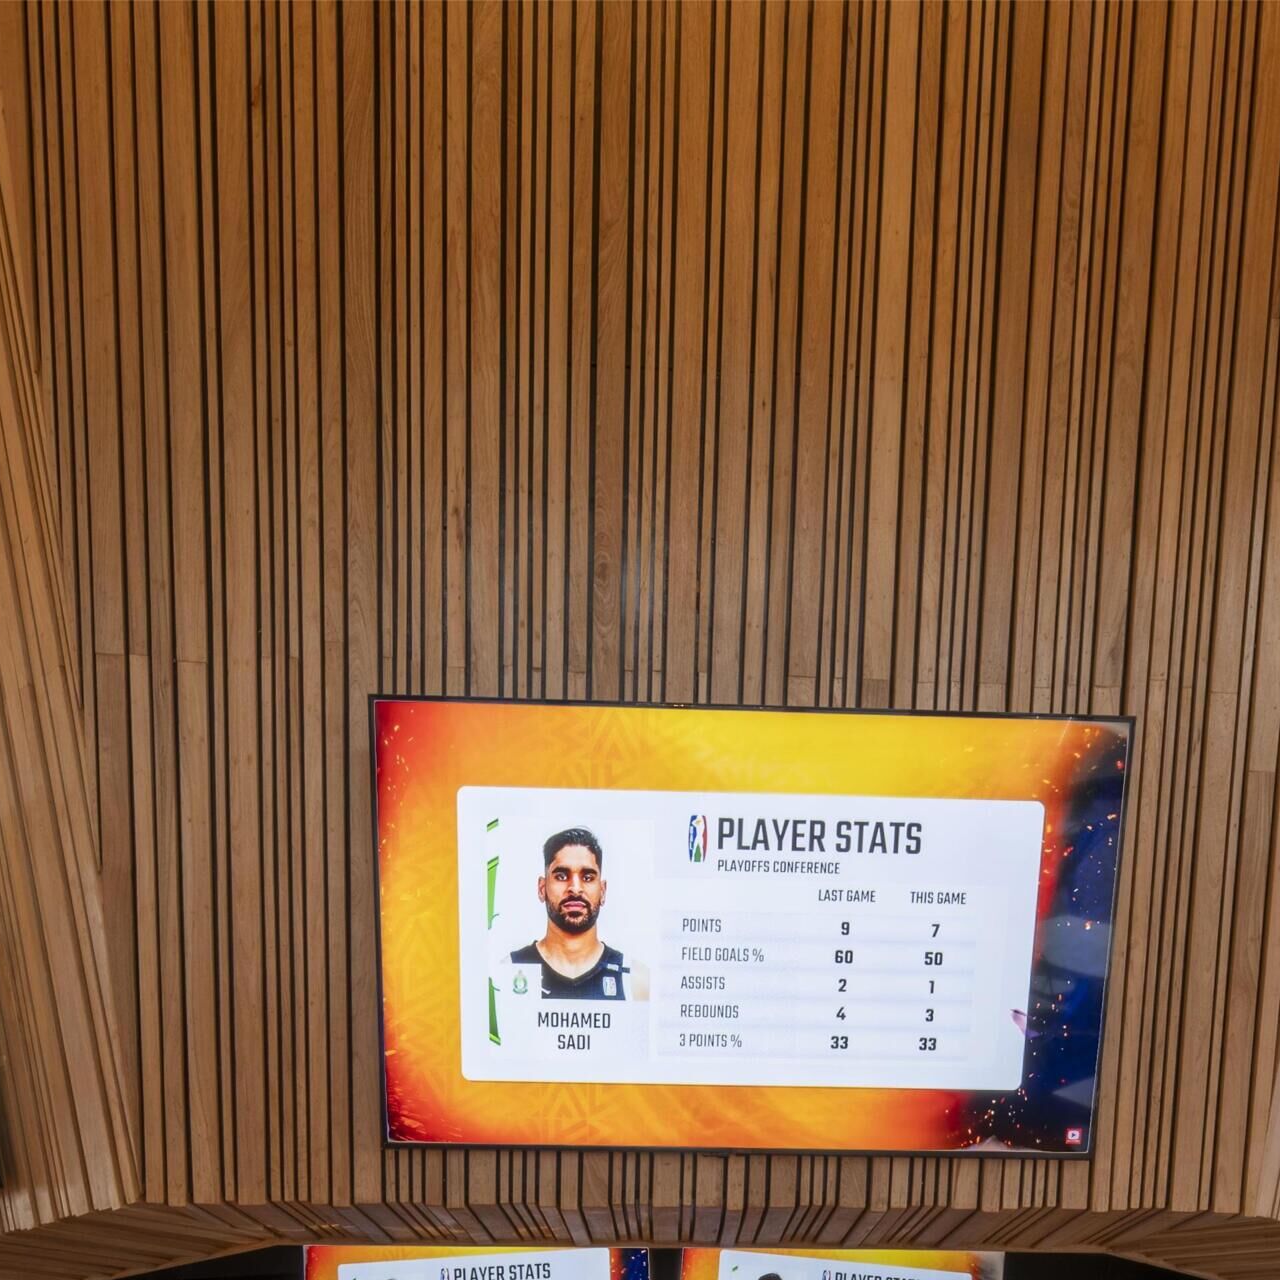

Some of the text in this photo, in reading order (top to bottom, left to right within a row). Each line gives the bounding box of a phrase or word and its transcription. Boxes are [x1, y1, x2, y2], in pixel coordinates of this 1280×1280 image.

[717, 817, 826, 853] PLAYER
[835, 820, 922, 855] STATS
[717, 860, 841, 875] PLAYOFFS CONFERENCE
[818, 889, 876, 903] LAST GAME
[910, 891, 967, 905] THIS GAME
[682, 918, 941, 938] POINTS 9 7
[681, 947, 943, 966] FIELD GOALS % 60 50
[680, 976, 936, 994] ASSISTS 2 1
[537, 1011, 612, 1029] MOHAMED
[680, 1004, 935, 1023] REBOUNDS 4 3
[557, 1034, 591, 1050] SADI
[679, 1033, 937, 1051] 3 POINTS % 33 33
[508, 1262, 551, 1280] STATS
